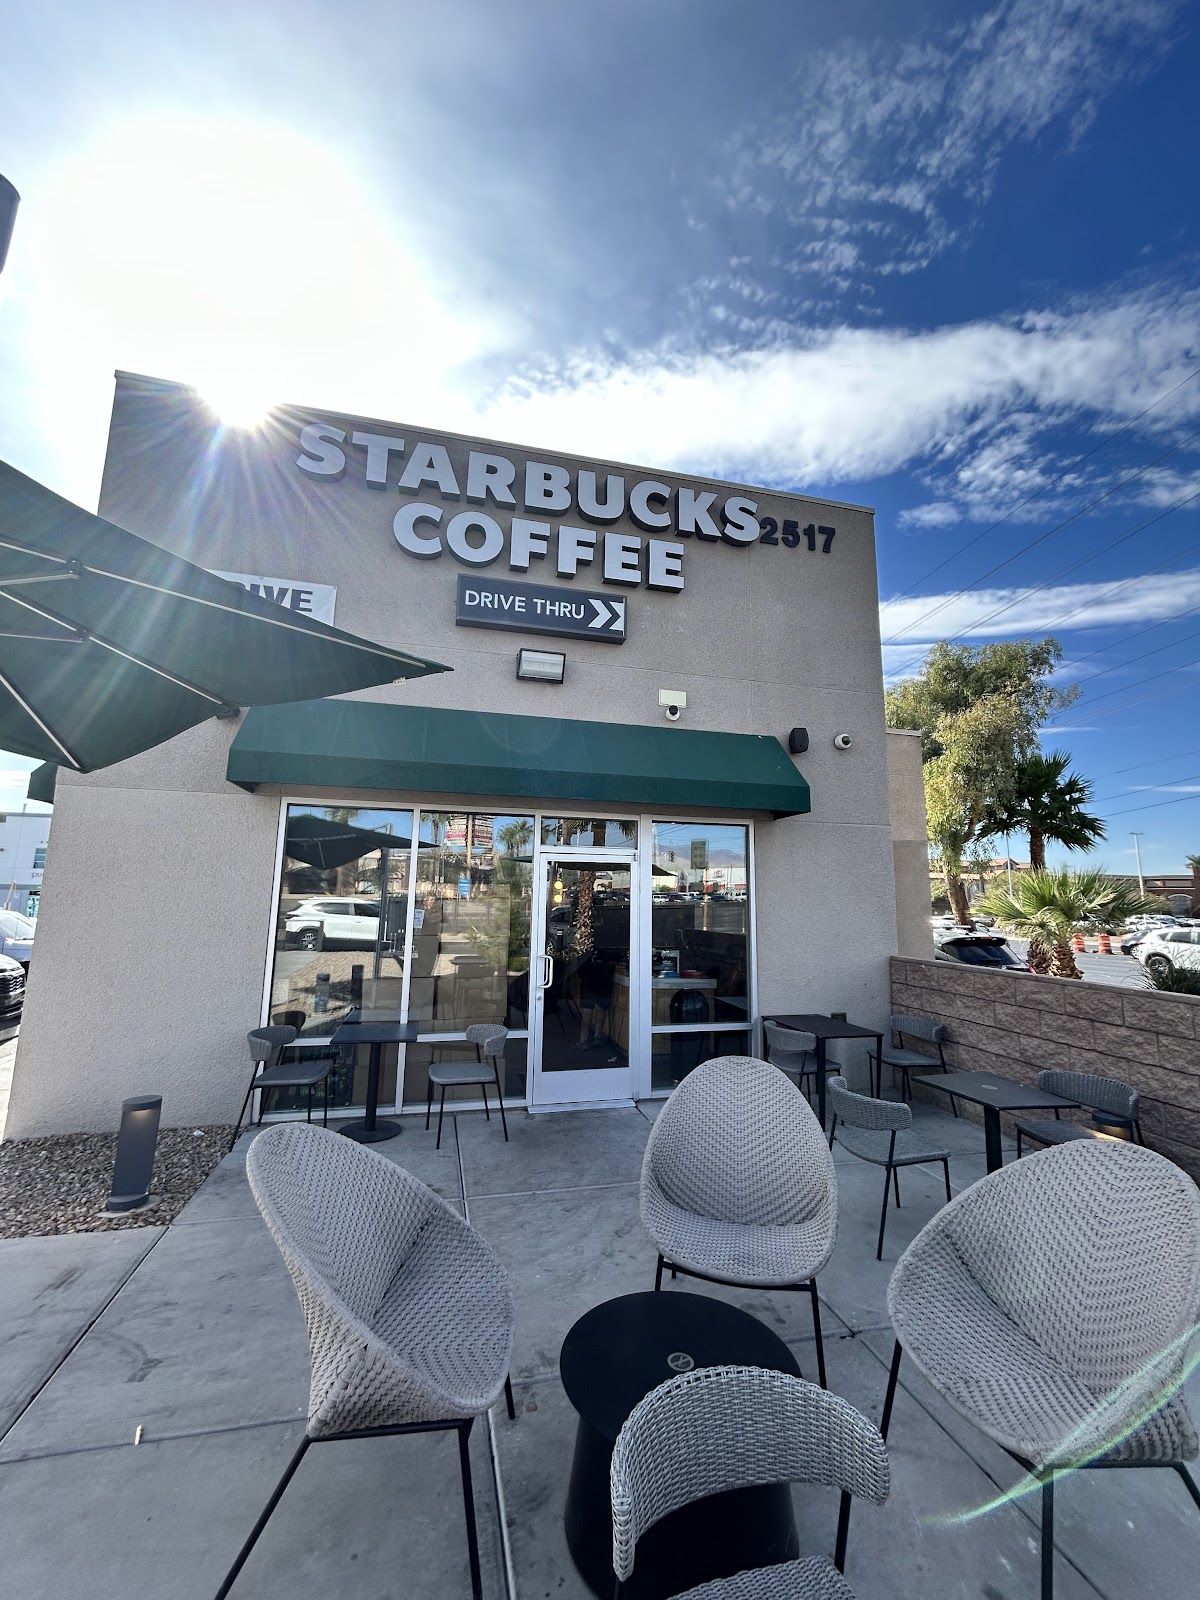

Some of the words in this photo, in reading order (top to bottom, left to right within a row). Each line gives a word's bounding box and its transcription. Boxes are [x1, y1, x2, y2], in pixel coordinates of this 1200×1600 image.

[296, 423, 760, 546] STARBUCKS
[393, 502, 684, 593] COFFEE
[760, 516, 836, 553] 2517
[465, 589, 526, 612] DRIVE
[533, 598, 585, 619] THRU
